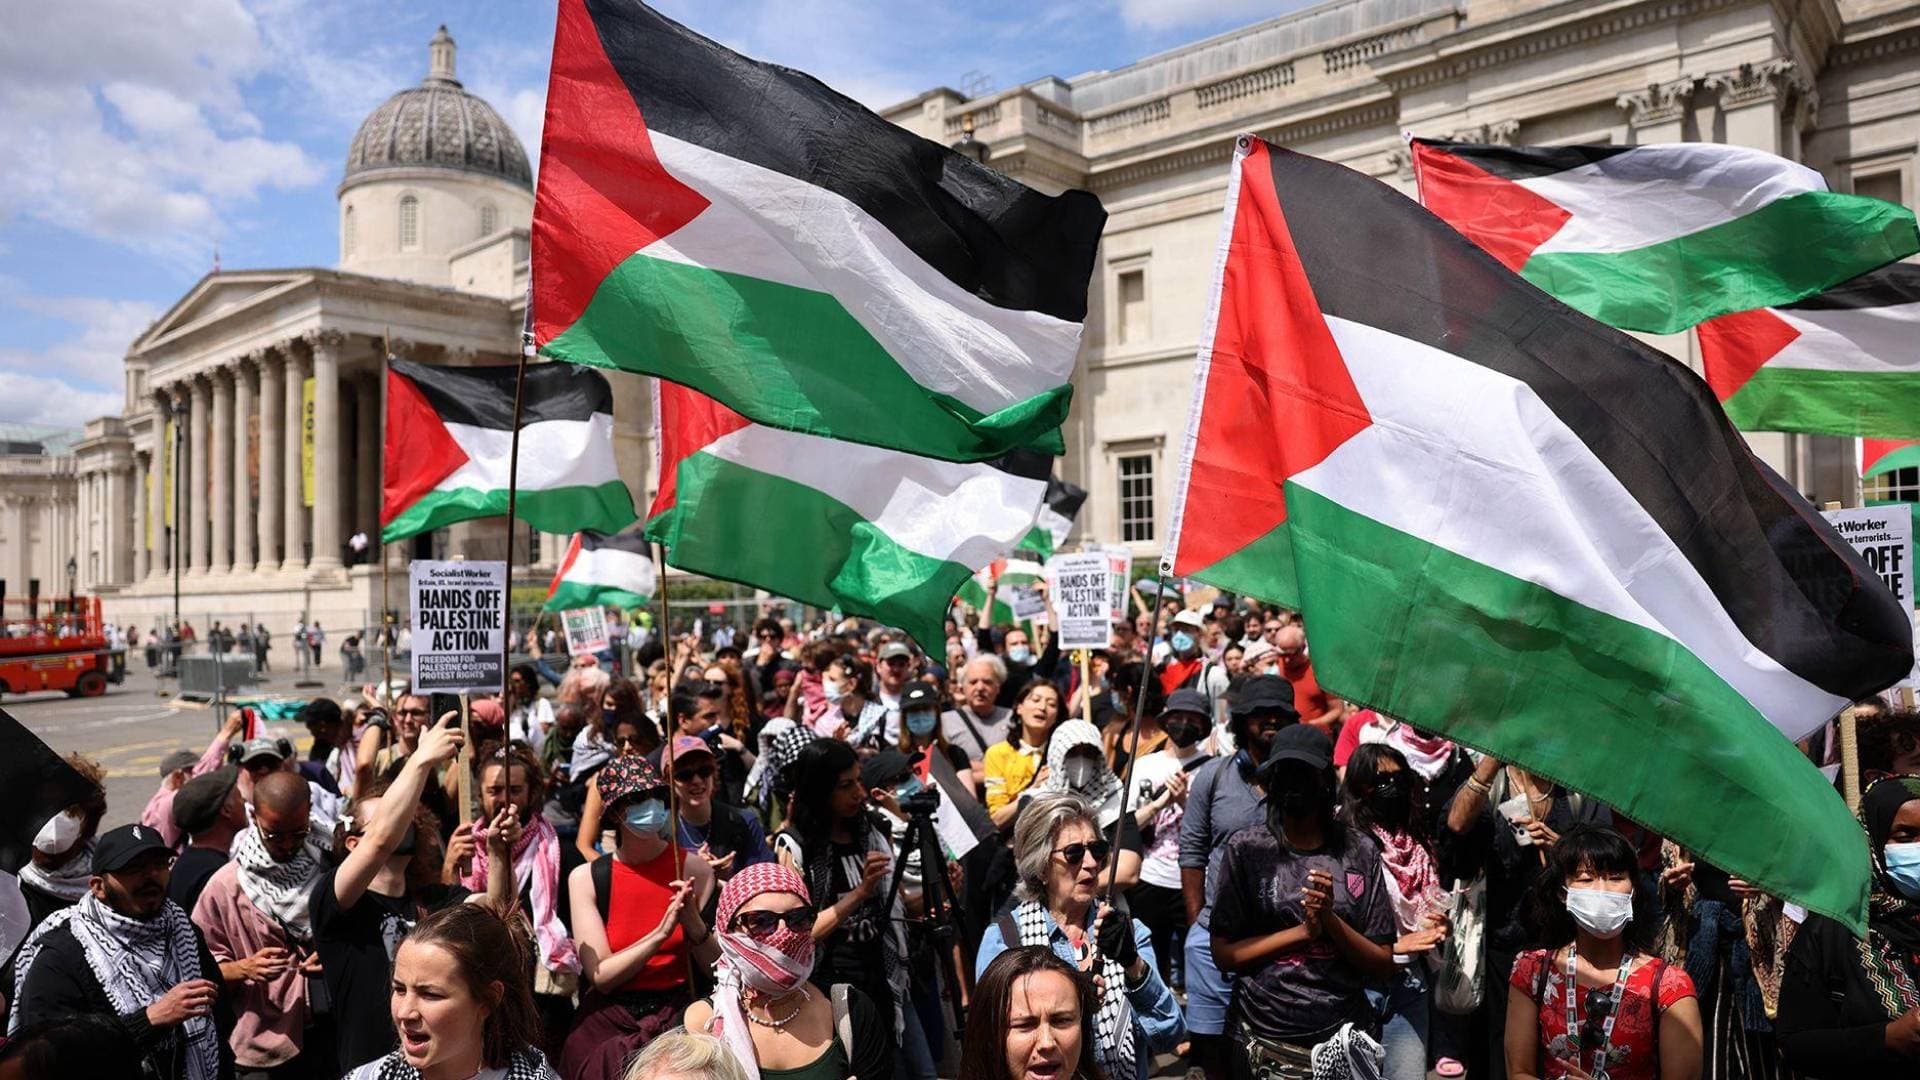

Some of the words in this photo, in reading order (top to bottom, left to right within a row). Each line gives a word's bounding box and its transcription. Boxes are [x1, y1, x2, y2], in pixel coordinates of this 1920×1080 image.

[1843, 519, 1887, 532] Worker
[1862, 544, 1904, 573] OFF
[430, 568, 464, 577] Socialist
[464, 568, 491, 577] Worker
[1059, 574, 1088, 588] HANDS
[1090, 573, 1106, 587] OFF
[419, 589, 472, 609] HANDS
[475, 589, 501, 608] OFF
[1061, 588, 1106, 603] PALESTINE
[1067, 603, 1100, 617] ACTION
[420, 610, 501, 630] PALESTINE
[432, 631, 489, 651] ACTION
[420, 655, 459, 664] FREEDOM
[420, 663, 462, 672] PALESTINE
[468, 662, 498, 670] DEFEND
[420, 671, 455, 680] PROTEST
[456, 670, 485, 679] RIGHTS
